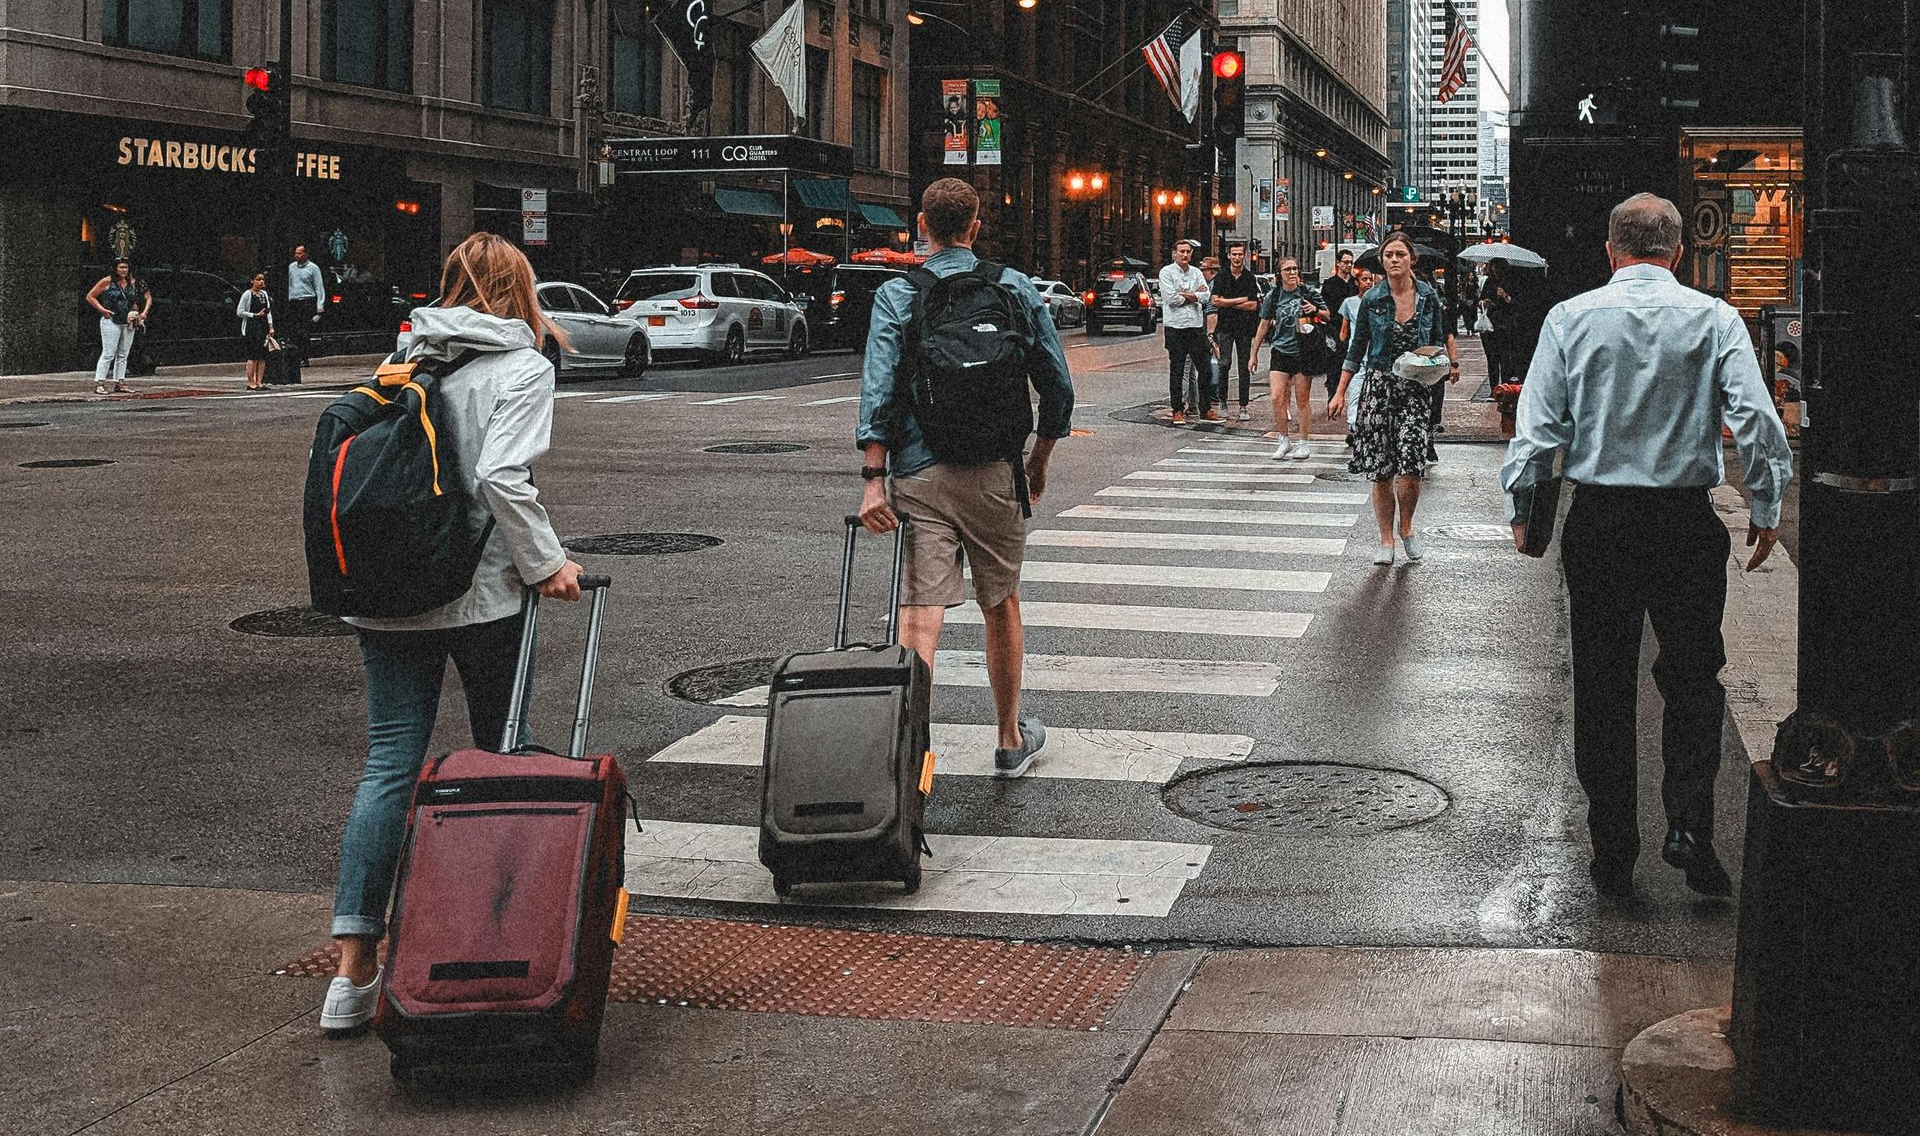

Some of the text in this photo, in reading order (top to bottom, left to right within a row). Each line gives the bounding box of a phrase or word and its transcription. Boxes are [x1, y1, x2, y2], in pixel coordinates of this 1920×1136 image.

[655, 148, 679, 156] LOOP
[691, 148, 710, 159] 111
[722, 145, 748, 161] CQ
[117, 137, 340, 180] STARBUCKS FFEE
[680, 309, 696, 317] 1013
